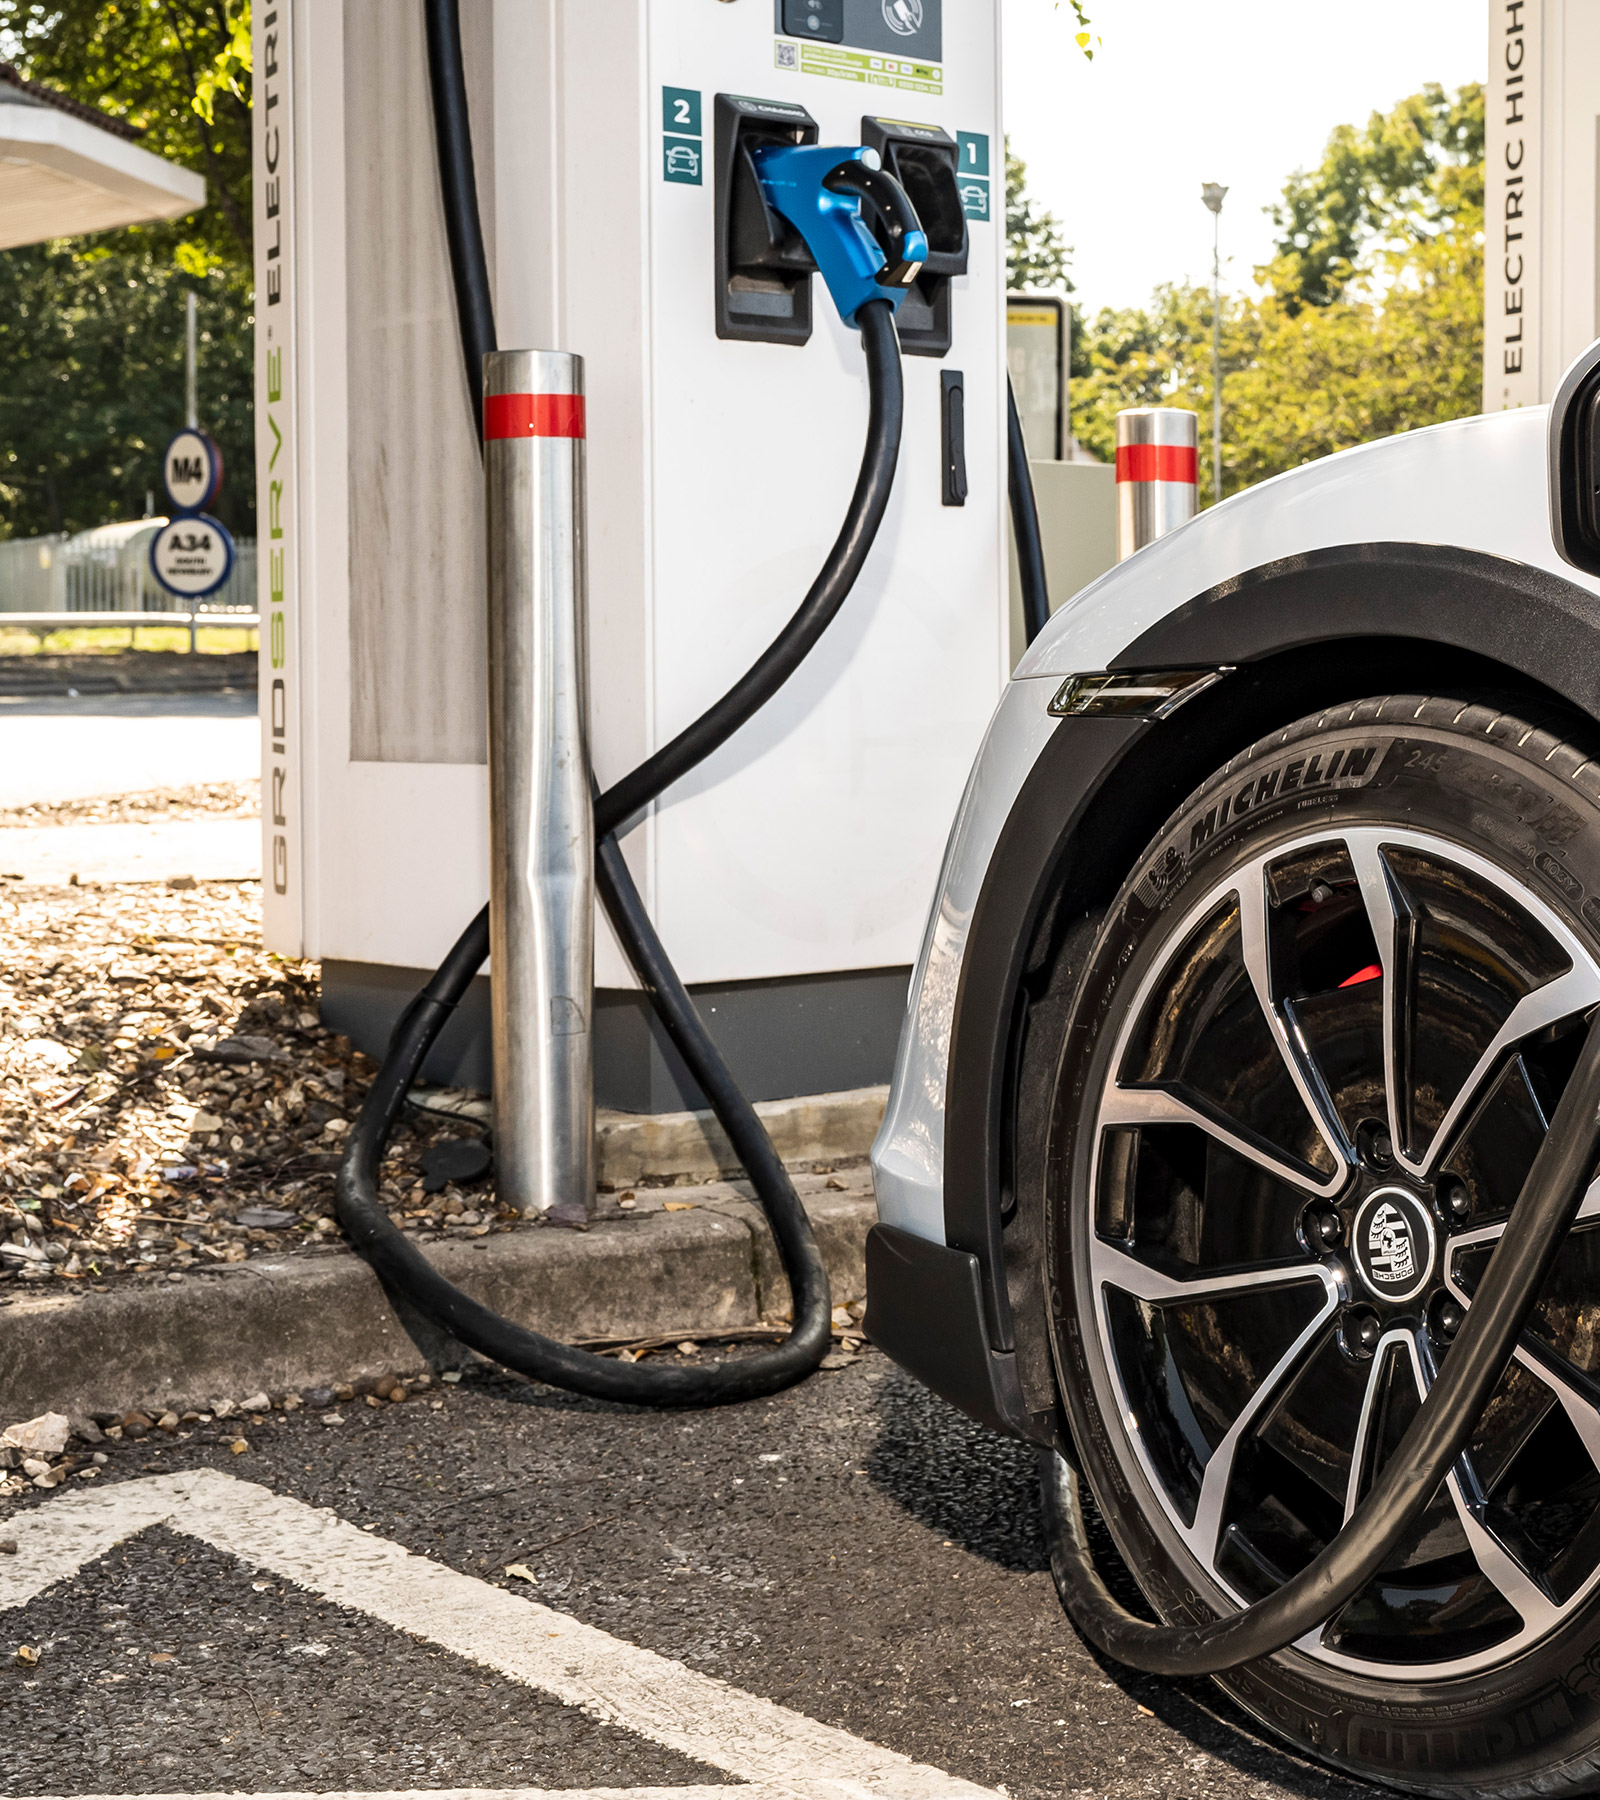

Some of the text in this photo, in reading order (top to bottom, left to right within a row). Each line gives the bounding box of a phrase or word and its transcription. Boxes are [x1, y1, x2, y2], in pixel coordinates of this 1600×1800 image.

[673, 99, 691, 124] 2
[264, 0, 281, 307] ELECTRI
[966, 142, 977, 165] 1
[1504, 0, 1524, 375] ELECTRIC HIGH
[172, 457, 203, 483] M4
[169, 534, 211, 551] A34
[1190, 748, 1377, 853] MICHELIN
[1542, 856, 1577, 890] 103Y
[1373, 1267, 1414, 1281] PORSCHE
[1355, 1693, 1577, 1763] MICHELIN
